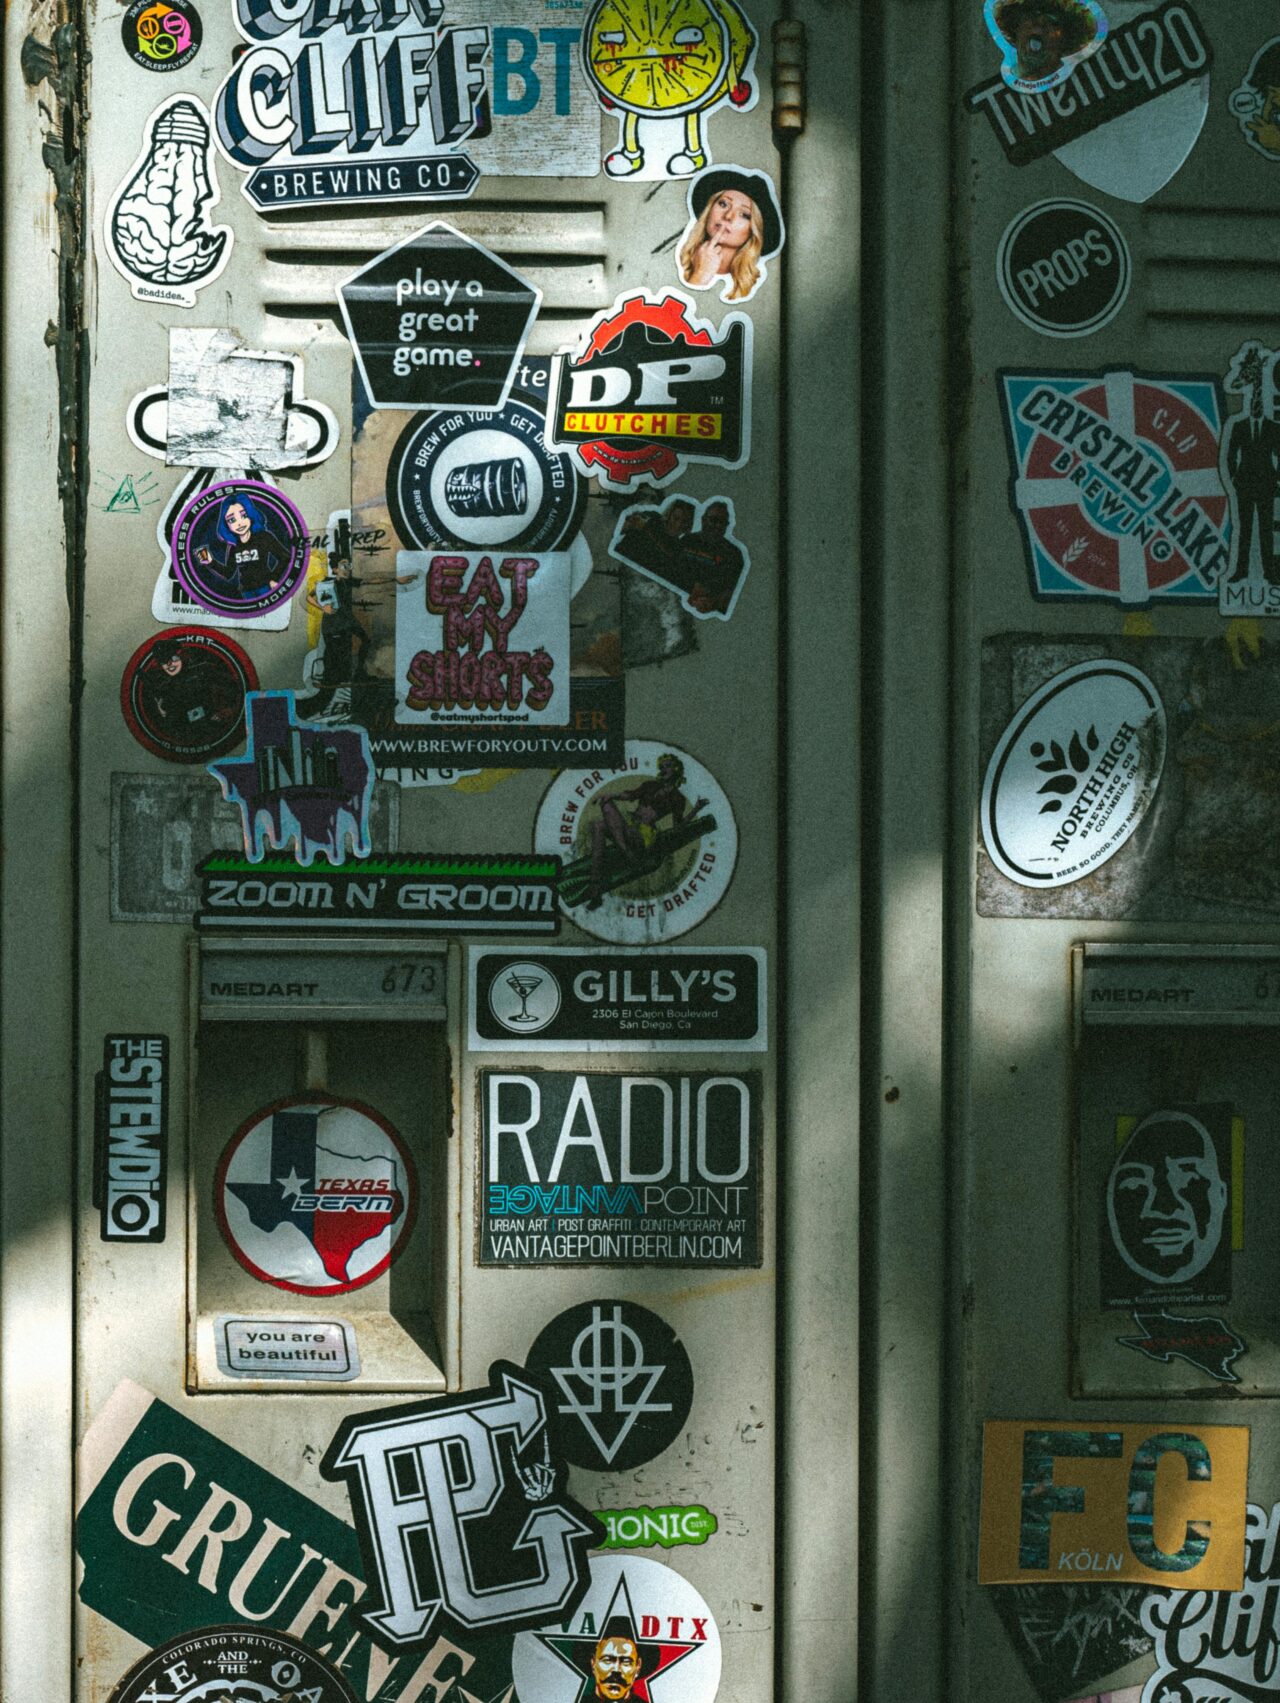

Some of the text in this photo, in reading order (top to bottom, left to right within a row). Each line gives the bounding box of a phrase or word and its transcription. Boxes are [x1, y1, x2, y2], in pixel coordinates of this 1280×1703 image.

[215, 26, 489, 166] CLIFF
[274, 163, 451, 197] BREWING CO
[1018, 229, 1113, 308] PROPS
[396, 268, 483, 306] play a
[399, 308, 479, 342] great
[393, 347, 481, 376] game.
[567, 355, 726, 408] DP
[414, 410, 537, 468] BREW FOR YOU GET
[567, 413, 716, 436] CLUTCHES
[1021, 390, 1160, 503] CRYSTAL
[1155, 488, 1229, 585] LAKE
[1055, 451, 1173, 560] BREWING
[179, 486, 235, 562] LESS RULES
[258, 578, 295, 607] MORE
[427, 556, 540, 613] EAT
[186, 635, 214, 646] KAT
[444, 603, 522, 653] MY
[406, 650, 554, 710] SHORTS
[430, 712, 529, 723] @eatmyshortspod
[1051, 722, 1137, 853] NORTH HIGH
[559, 770, 604, 846] BREW FOR
[1080, 774, 1122, 839] BREWING
[1095, 780, 1131, 833] COLUMBUS,
[625, 851, 717, 918] GET DRAFTED
[1056, 866, 1078, 878] BEER
[207, 878, 554, 912] ZOOM N' GROOM
[210, 964, 437, 997] MEDART 673
[573, 970, 737, 1002] GILLY'S
[1091, 989, 1194, 1003] MEDART
[592, 1009, 718, 1021] 2306 Cajon Boulevard
[619, 1020, 639, 1030] San
[110, 1039, 162, 1057] THE
[489, 1075, 750, 1183] RADIO
[318, 1178, 390, 1191] TEXAS
[489, 1185, 748, 1215] VANTAGE POINT
[292, 1194, 394, 1213] BERM
[490, 1219, 746, 1232] URBAN ART POST GRAFFITI CONTEMPORARY ART
[490, 1235, 742, 1259] VANTAGEPOINTBERLIN.COM
[246, 1331, 325, 1345] you are
[238, 1347, 337, 1362] beautiful
[1019, 1430, 1212, 1573] FC
[1058, 1549, 1124, 1571] KÖLN
[161, 1636, 308, 1664] COLORADO CO
[218, 1651, 248, 1661] AND
[218, 1663, 248, 1674] THE
